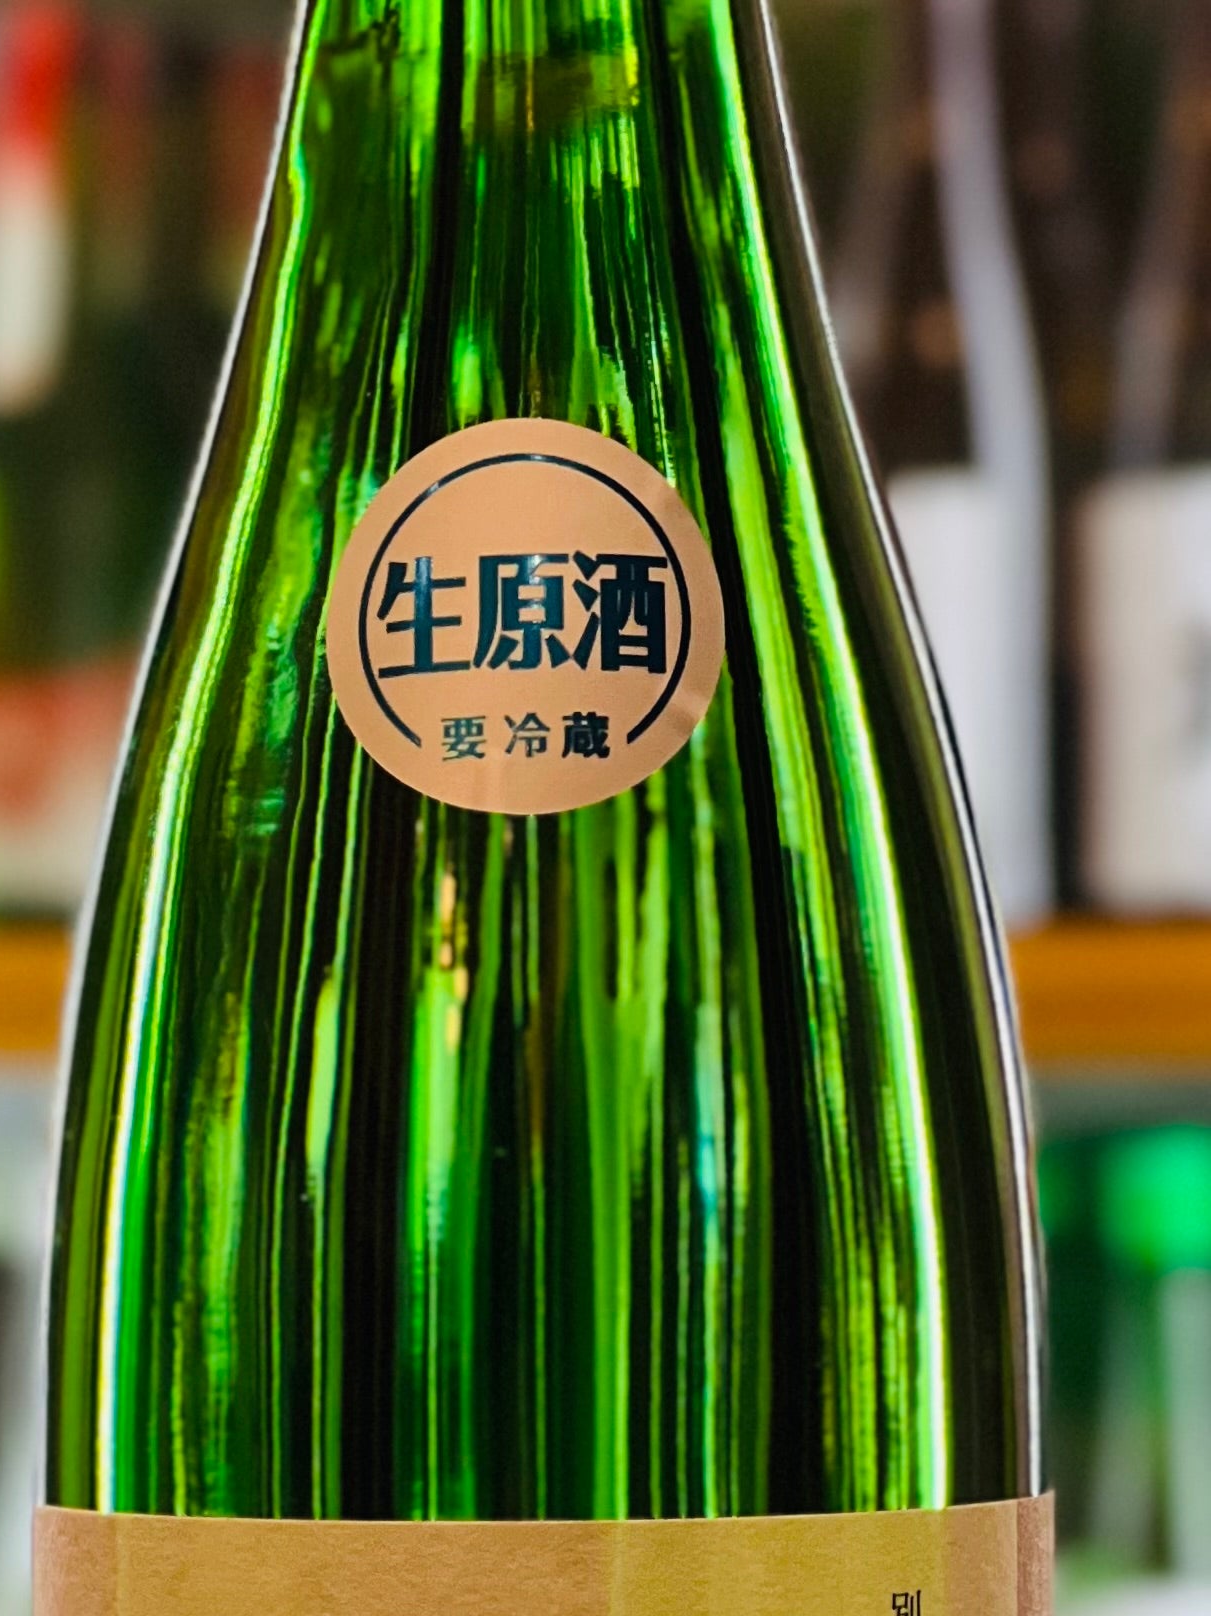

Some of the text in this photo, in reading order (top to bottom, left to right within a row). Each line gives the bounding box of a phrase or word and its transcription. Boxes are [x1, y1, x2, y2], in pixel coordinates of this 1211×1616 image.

[377, 550, 669, 680] 生原酒
[440, 711, 611, 762] 要冷蔵
